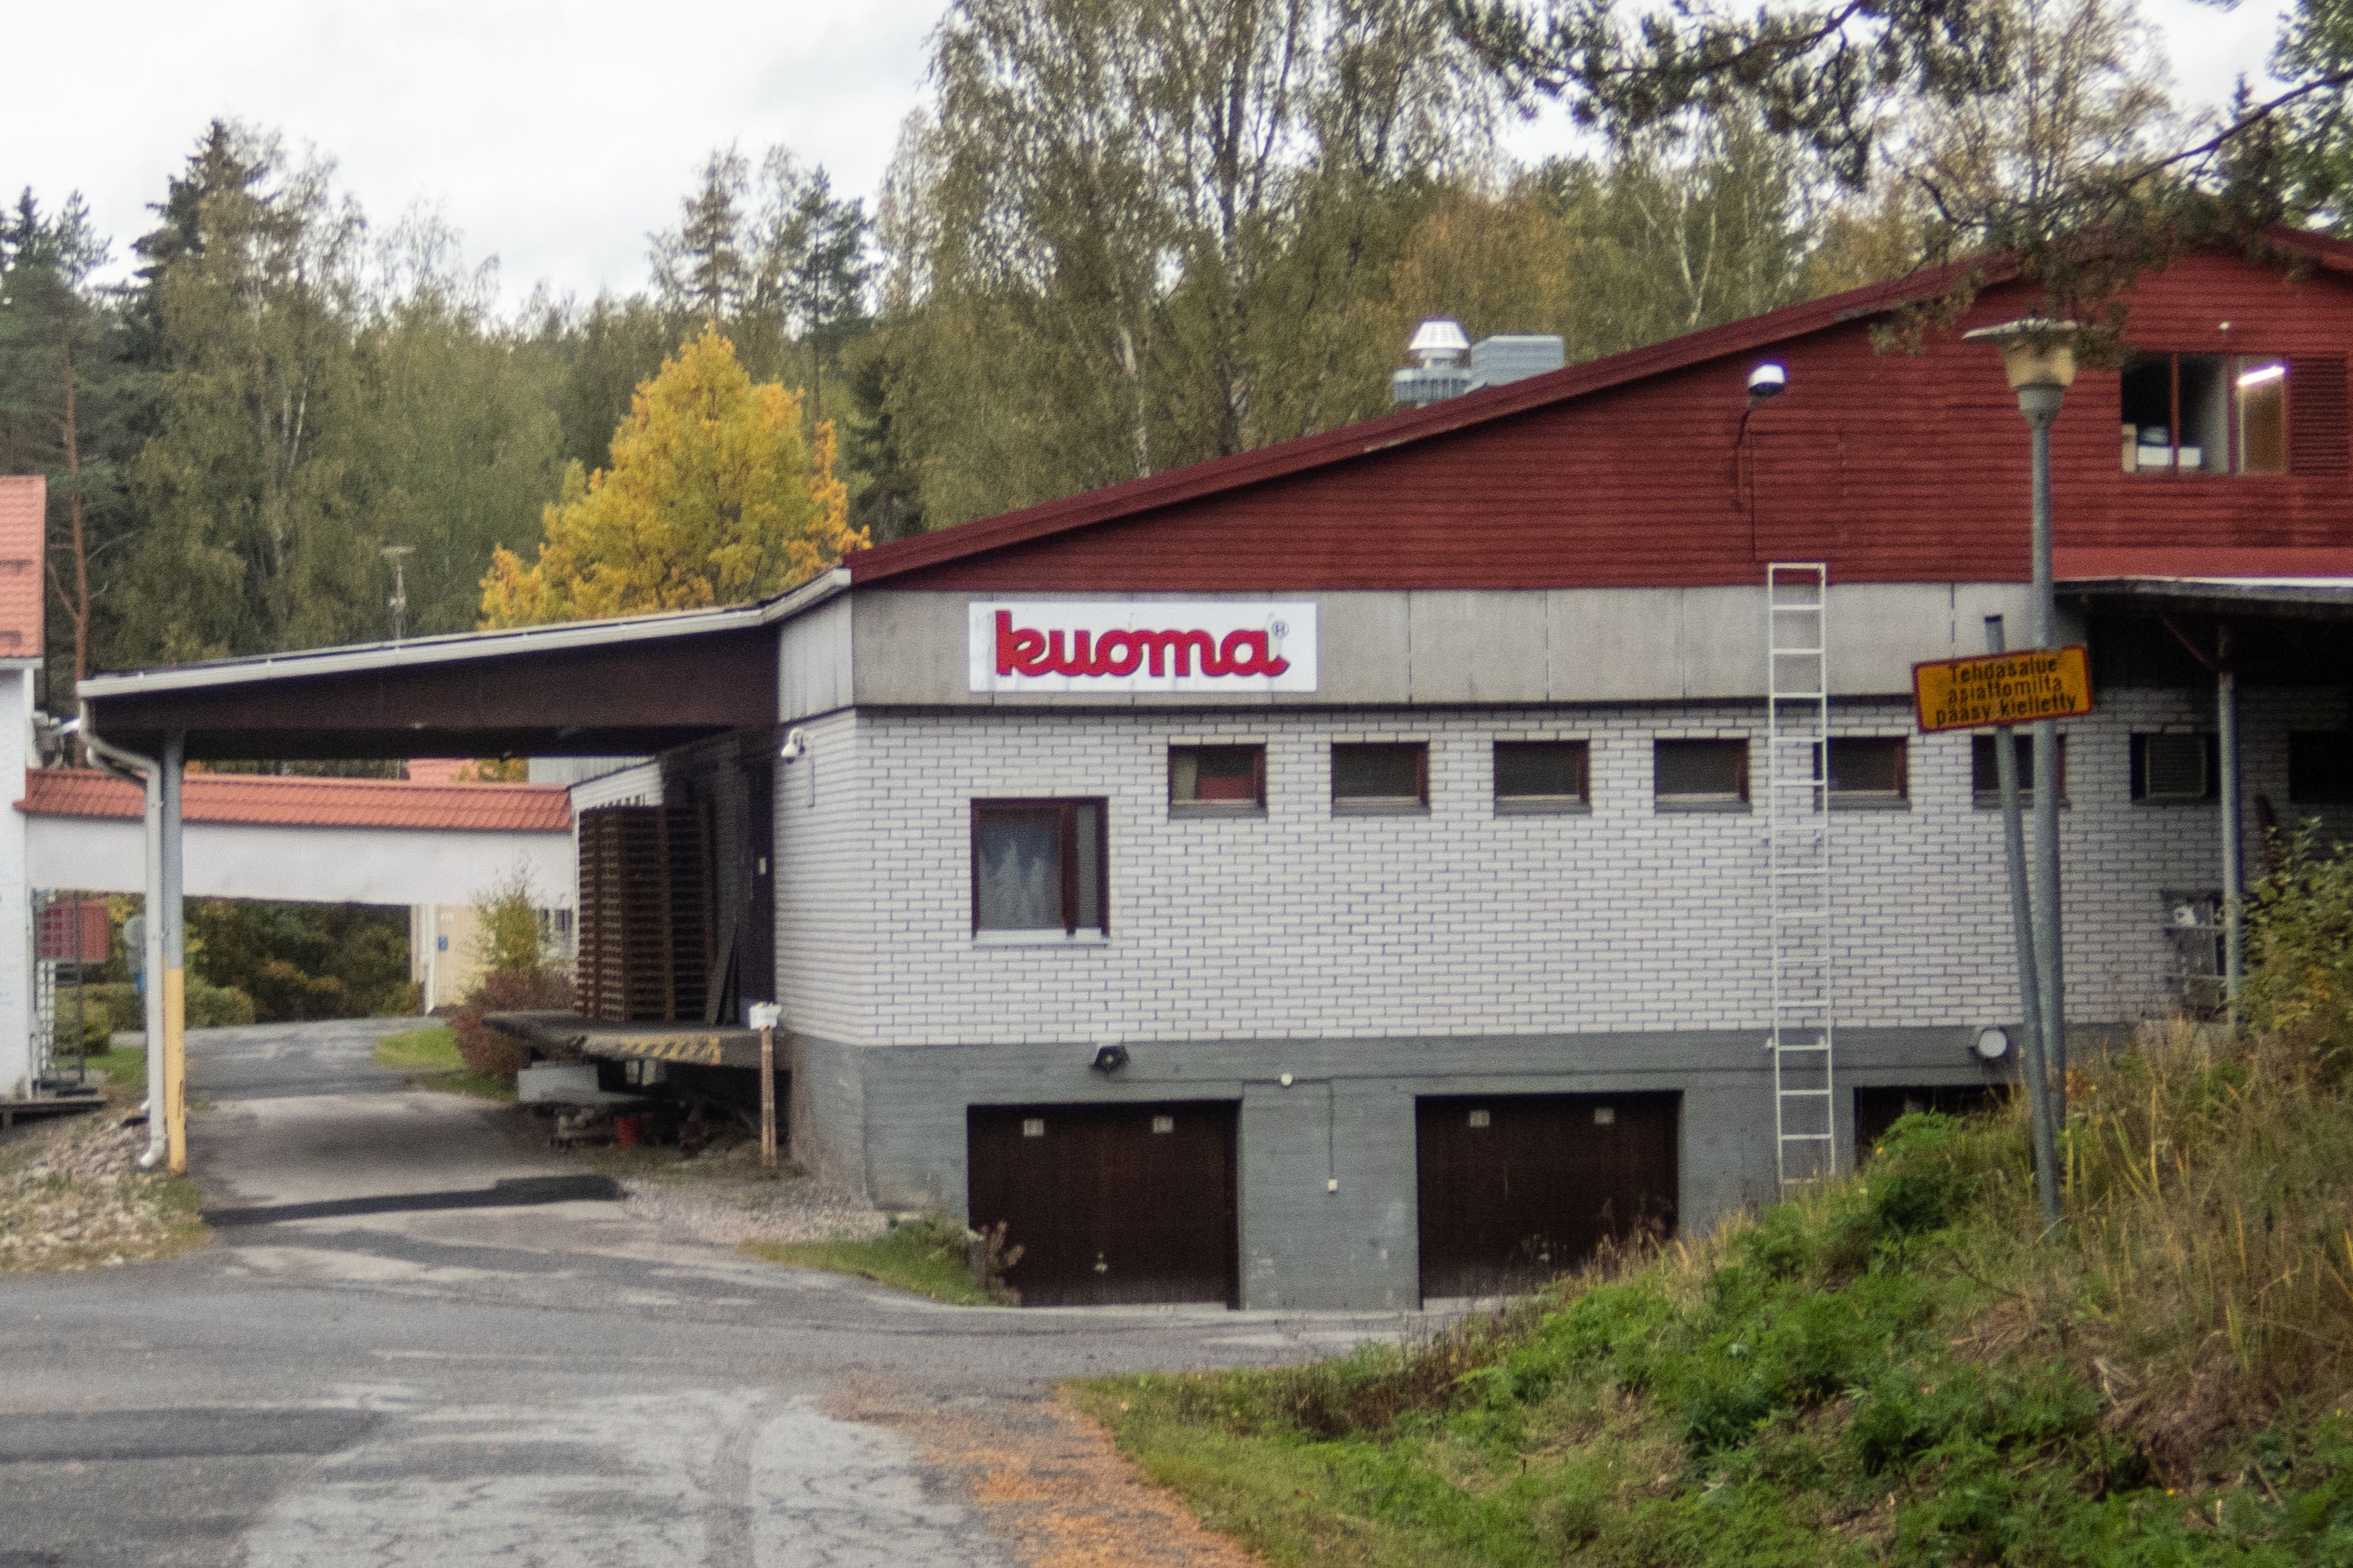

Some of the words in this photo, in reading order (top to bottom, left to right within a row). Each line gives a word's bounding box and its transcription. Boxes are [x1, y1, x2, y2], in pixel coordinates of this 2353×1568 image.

[1949, 657, 2057, 683] Tehdasalue
[1948, 675, 2063, 705] asiattomilta
[2000, 693, 2076, 716] kielletty
